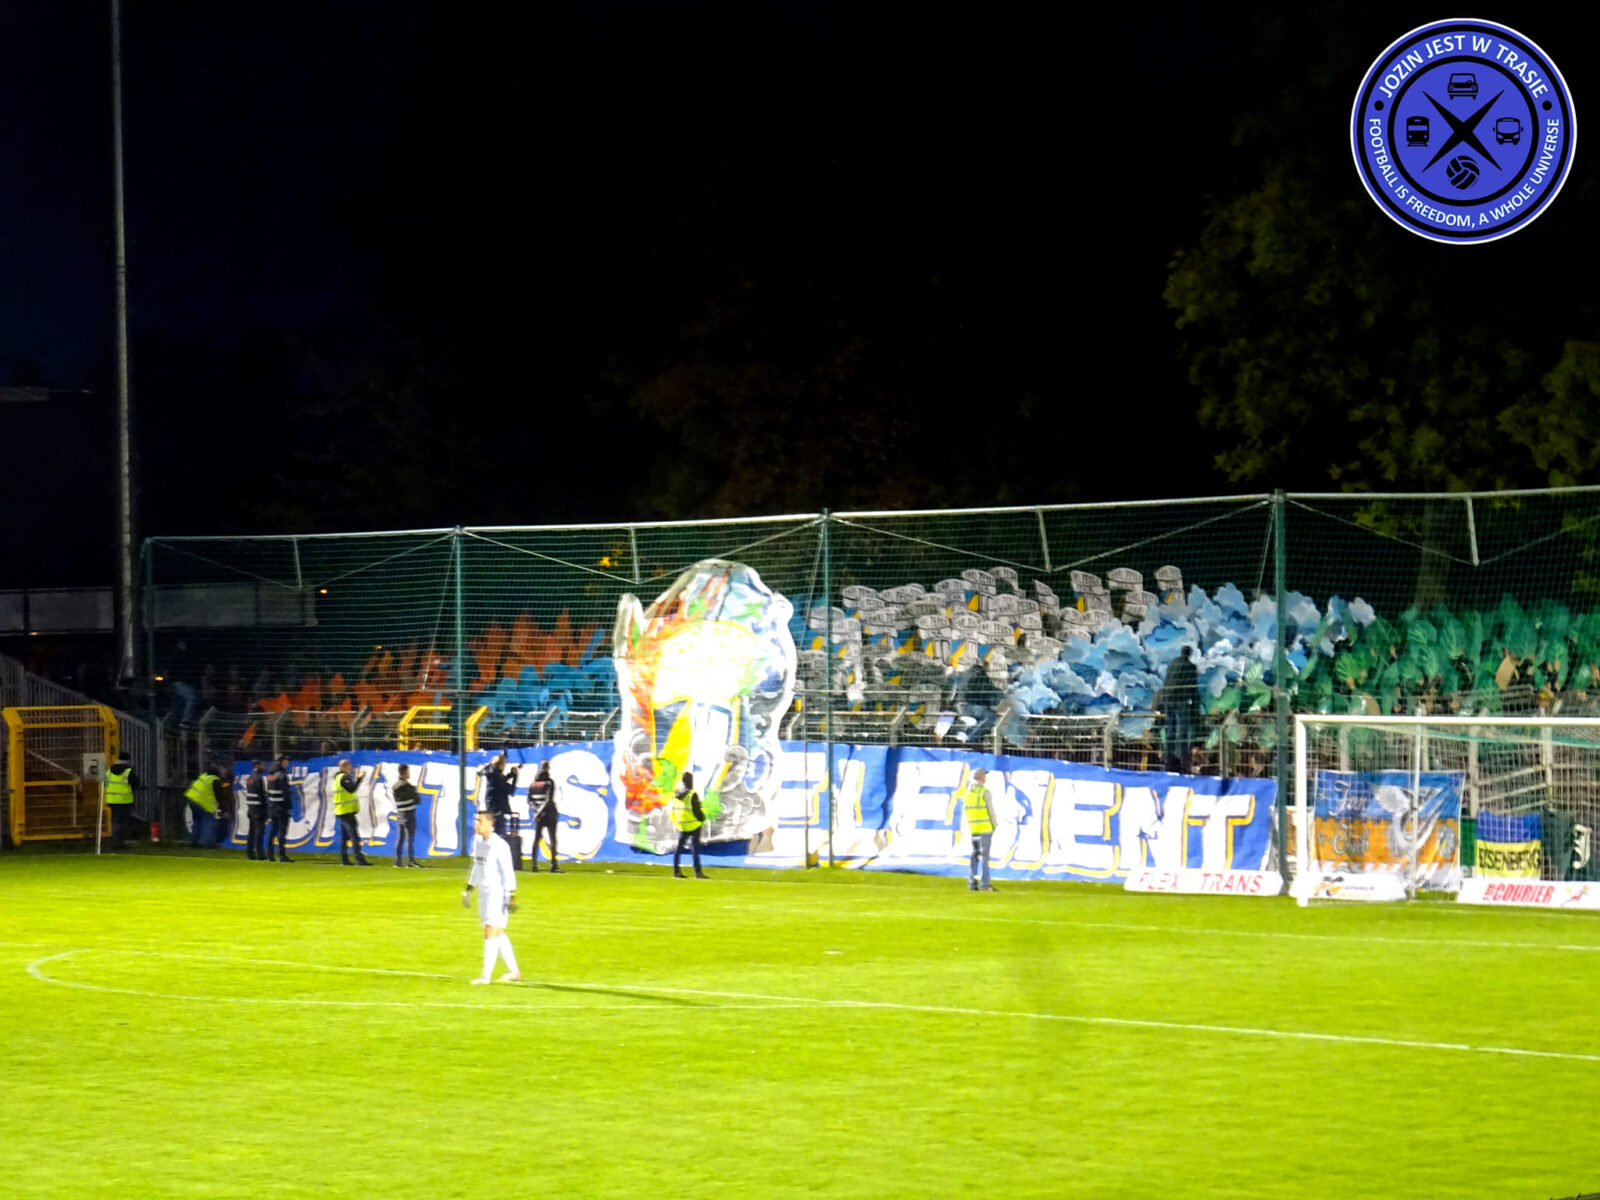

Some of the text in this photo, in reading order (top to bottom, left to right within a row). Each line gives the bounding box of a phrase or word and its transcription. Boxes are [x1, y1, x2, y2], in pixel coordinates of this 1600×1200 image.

[755, 752, 1256, 876] ELEMENT
[1478, 847, 1541, 872] EISENBERG
[1200, 872, 1264, 894] TRANS
[1492, 883, 1556, 904] COURIER
